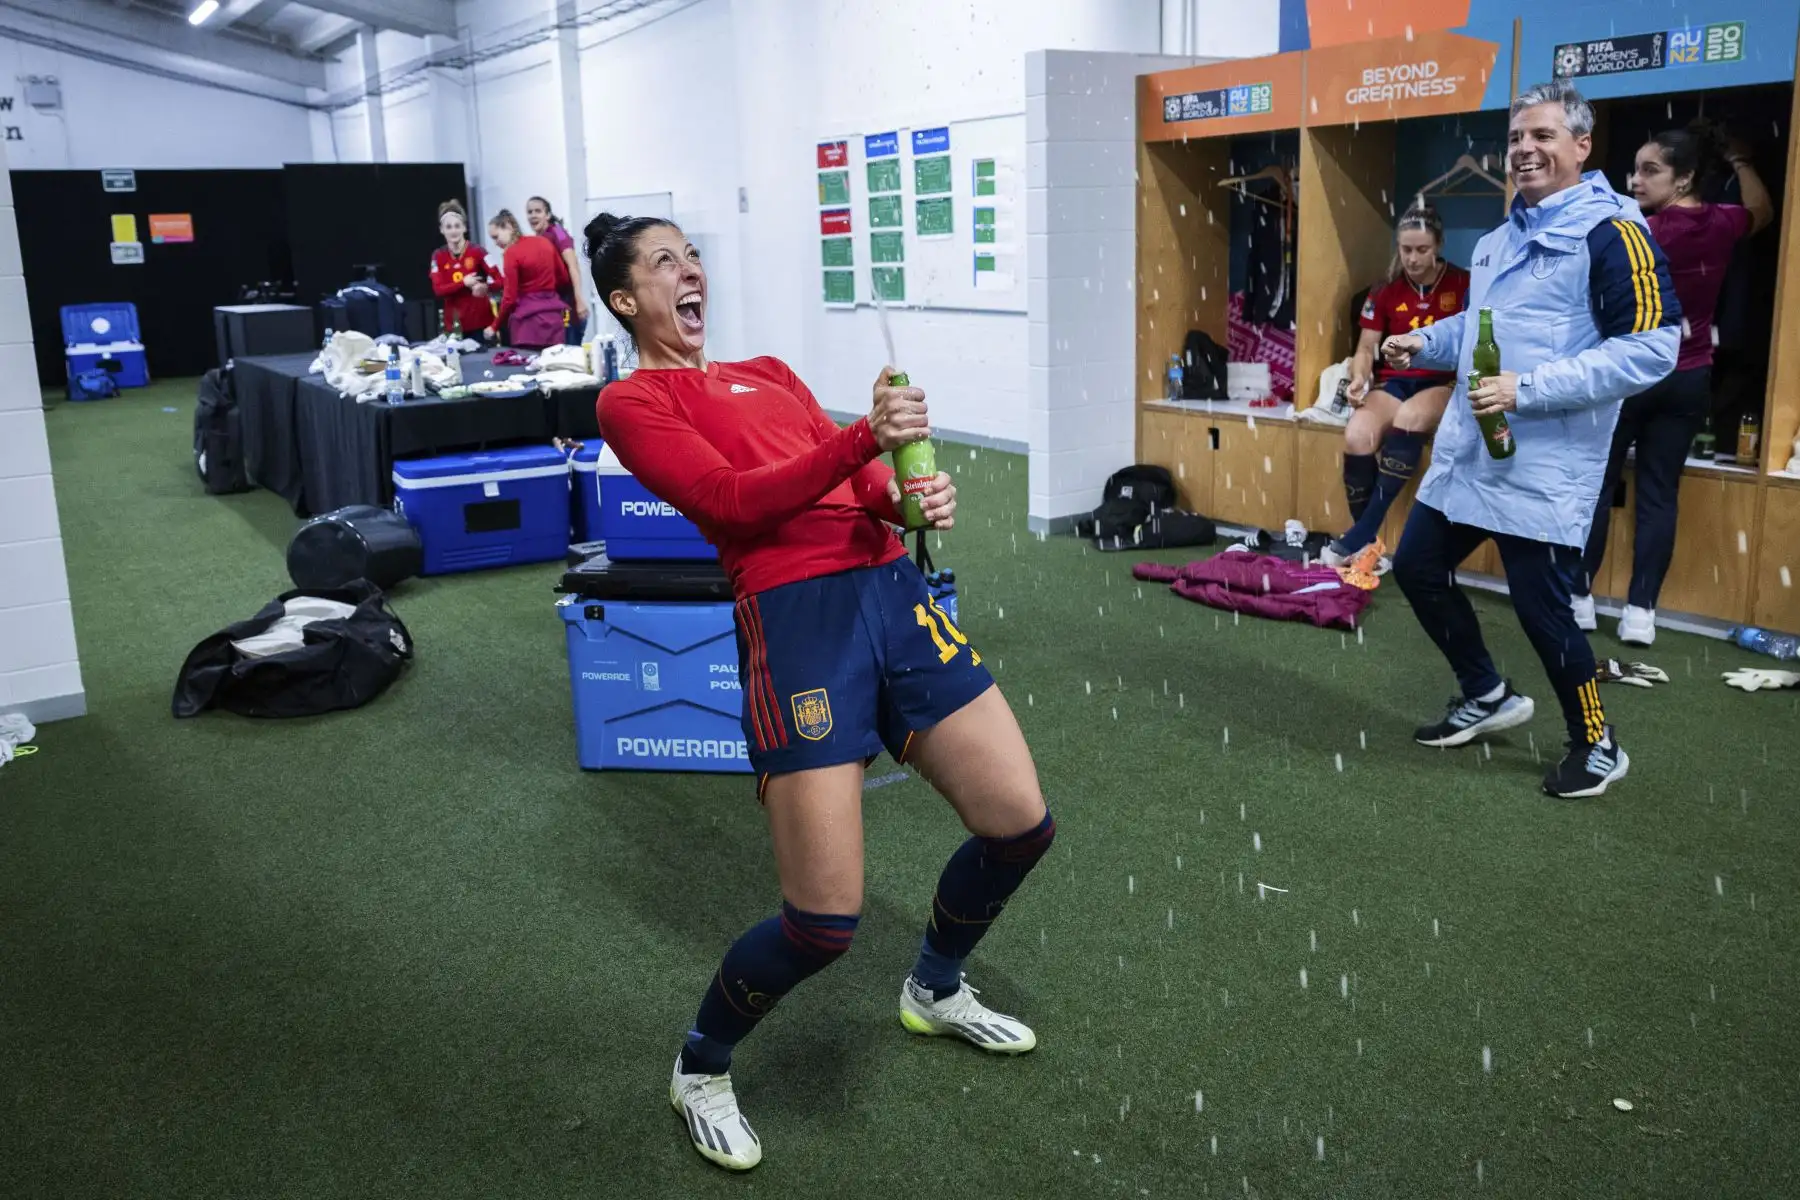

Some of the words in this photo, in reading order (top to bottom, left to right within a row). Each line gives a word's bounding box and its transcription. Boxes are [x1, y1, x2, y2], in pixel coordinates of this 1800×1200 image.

[1671, 31, 1701, 47] AU
[1708, 26, 1740, 43] 20
[1587, 41, 1614, 53] FIFA
[1707, 42, 1739, 60] 23
[1587, 49, 1639, 62] WOMEN'S
[1669, 48, 1699, 64] NZ
[1362, 61, 1439, 85] BEYOND
[1587, 61, 1623, 73] WORLD
[1626, 58, 1649, 69] CUP
[1230, 88, 1249, 100] AU
[1230, 100, 1248, 112] NZ
[621, 501, 684, 517] POWE
[582, 672, 631, 681] POWERADE
[617, 737, 749, 759] POWERADE
